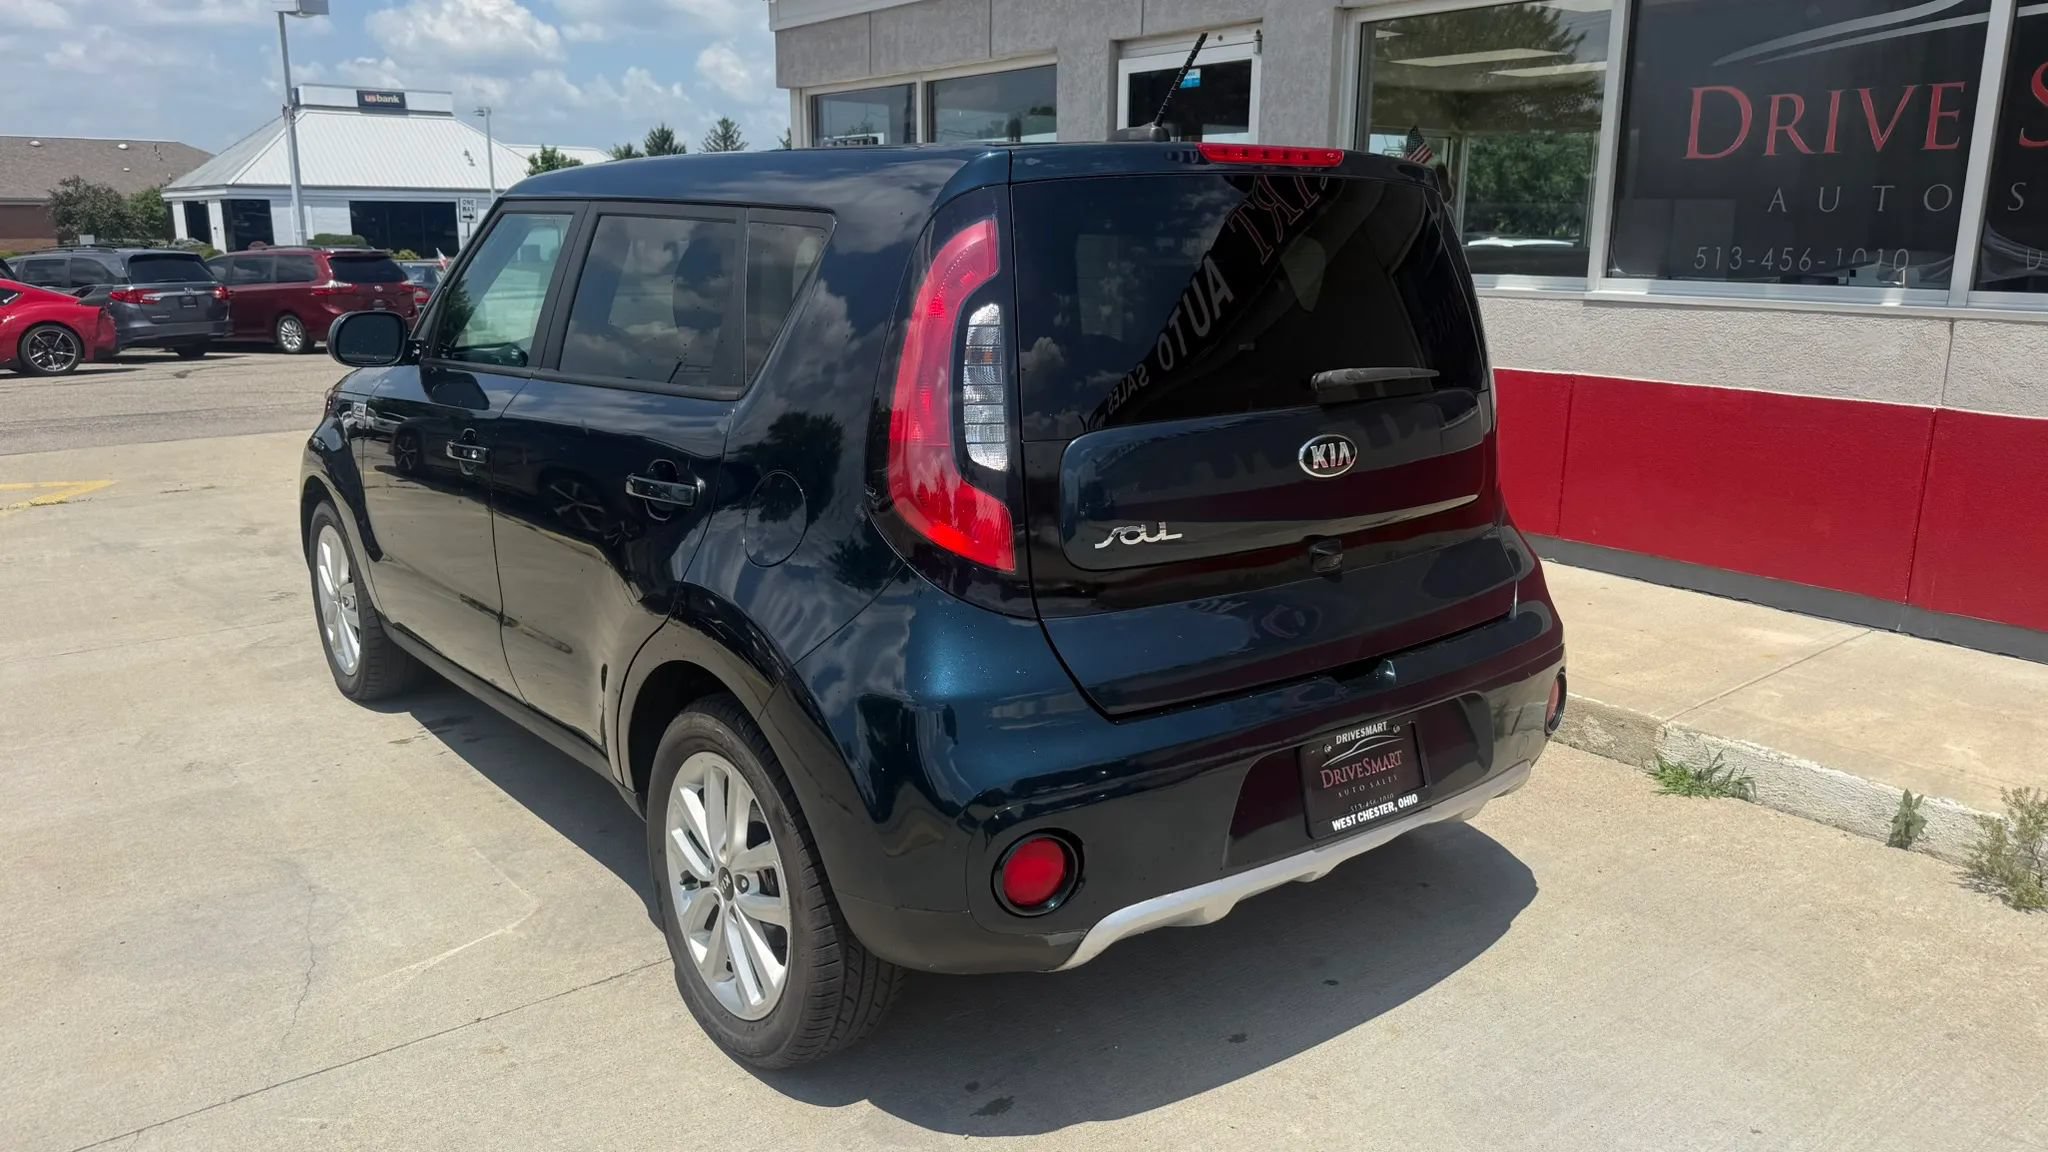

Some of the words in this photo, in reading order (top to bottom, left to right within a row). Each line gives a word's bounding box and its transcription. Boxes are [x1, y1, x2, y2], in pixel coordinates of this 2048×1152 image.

[1682, 81, 1966, 160] DRIVE
[1767, 183, 1953, 214] AUTO
[1310, 440, 1351, 469] KIA
[1095, 521, 1183, 549] SOUL
[1336, 721, 1388, 745] DRIVESMART
[1332, 814, 1357, 831] WEST
[1357, 801, 1398, 823] CHESTER,
[1398, 793, 1418, 809] OHIO
